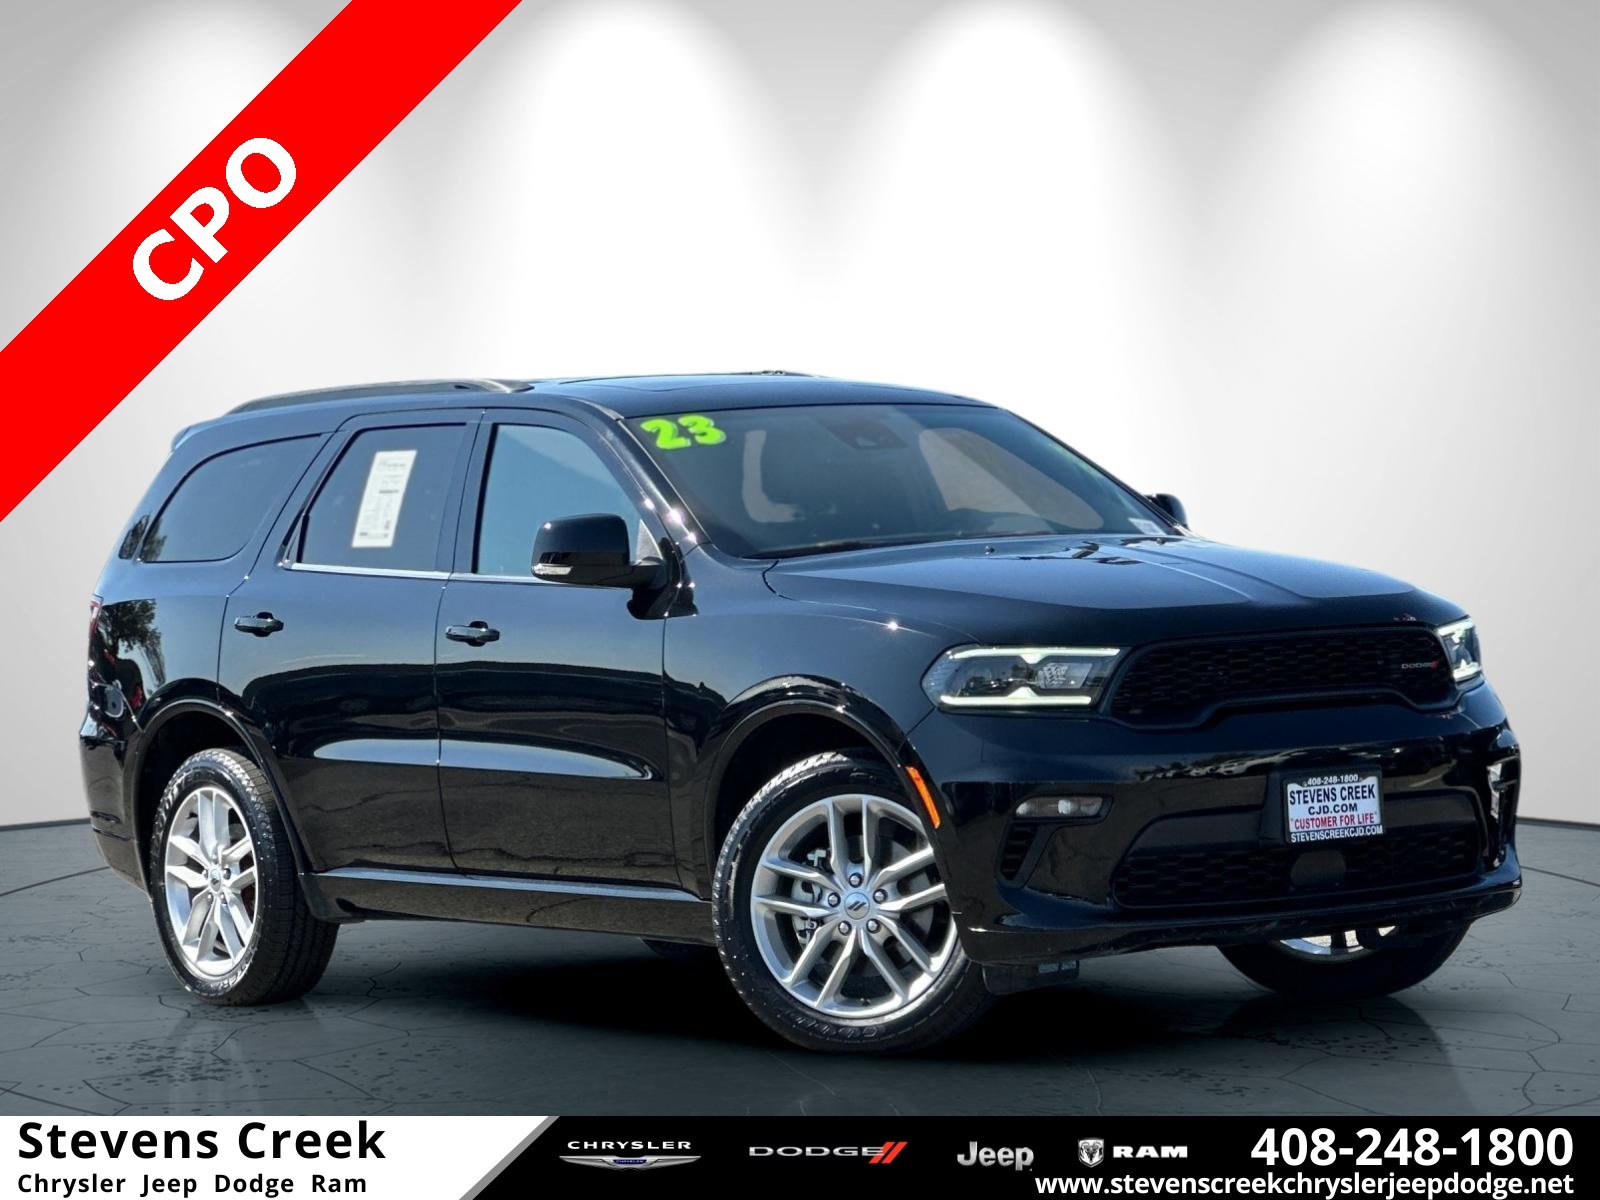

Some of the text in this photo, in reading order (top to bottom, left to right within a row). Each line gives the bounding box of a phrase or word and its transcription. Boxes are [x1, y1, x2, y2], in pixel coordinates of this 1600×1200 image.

[640, 415, 727, 450] 23
[1307, 774, 1359, 786] 408-248-1800
[1289, 784, 1376, 805] STEVENS CREEK
[1308, 802, 1358, 815] CJD.COM
[1340, 814, 1355, 826] FOR
[1291, 825, 1383, 843] STEVENSCREEKCJD.COM
